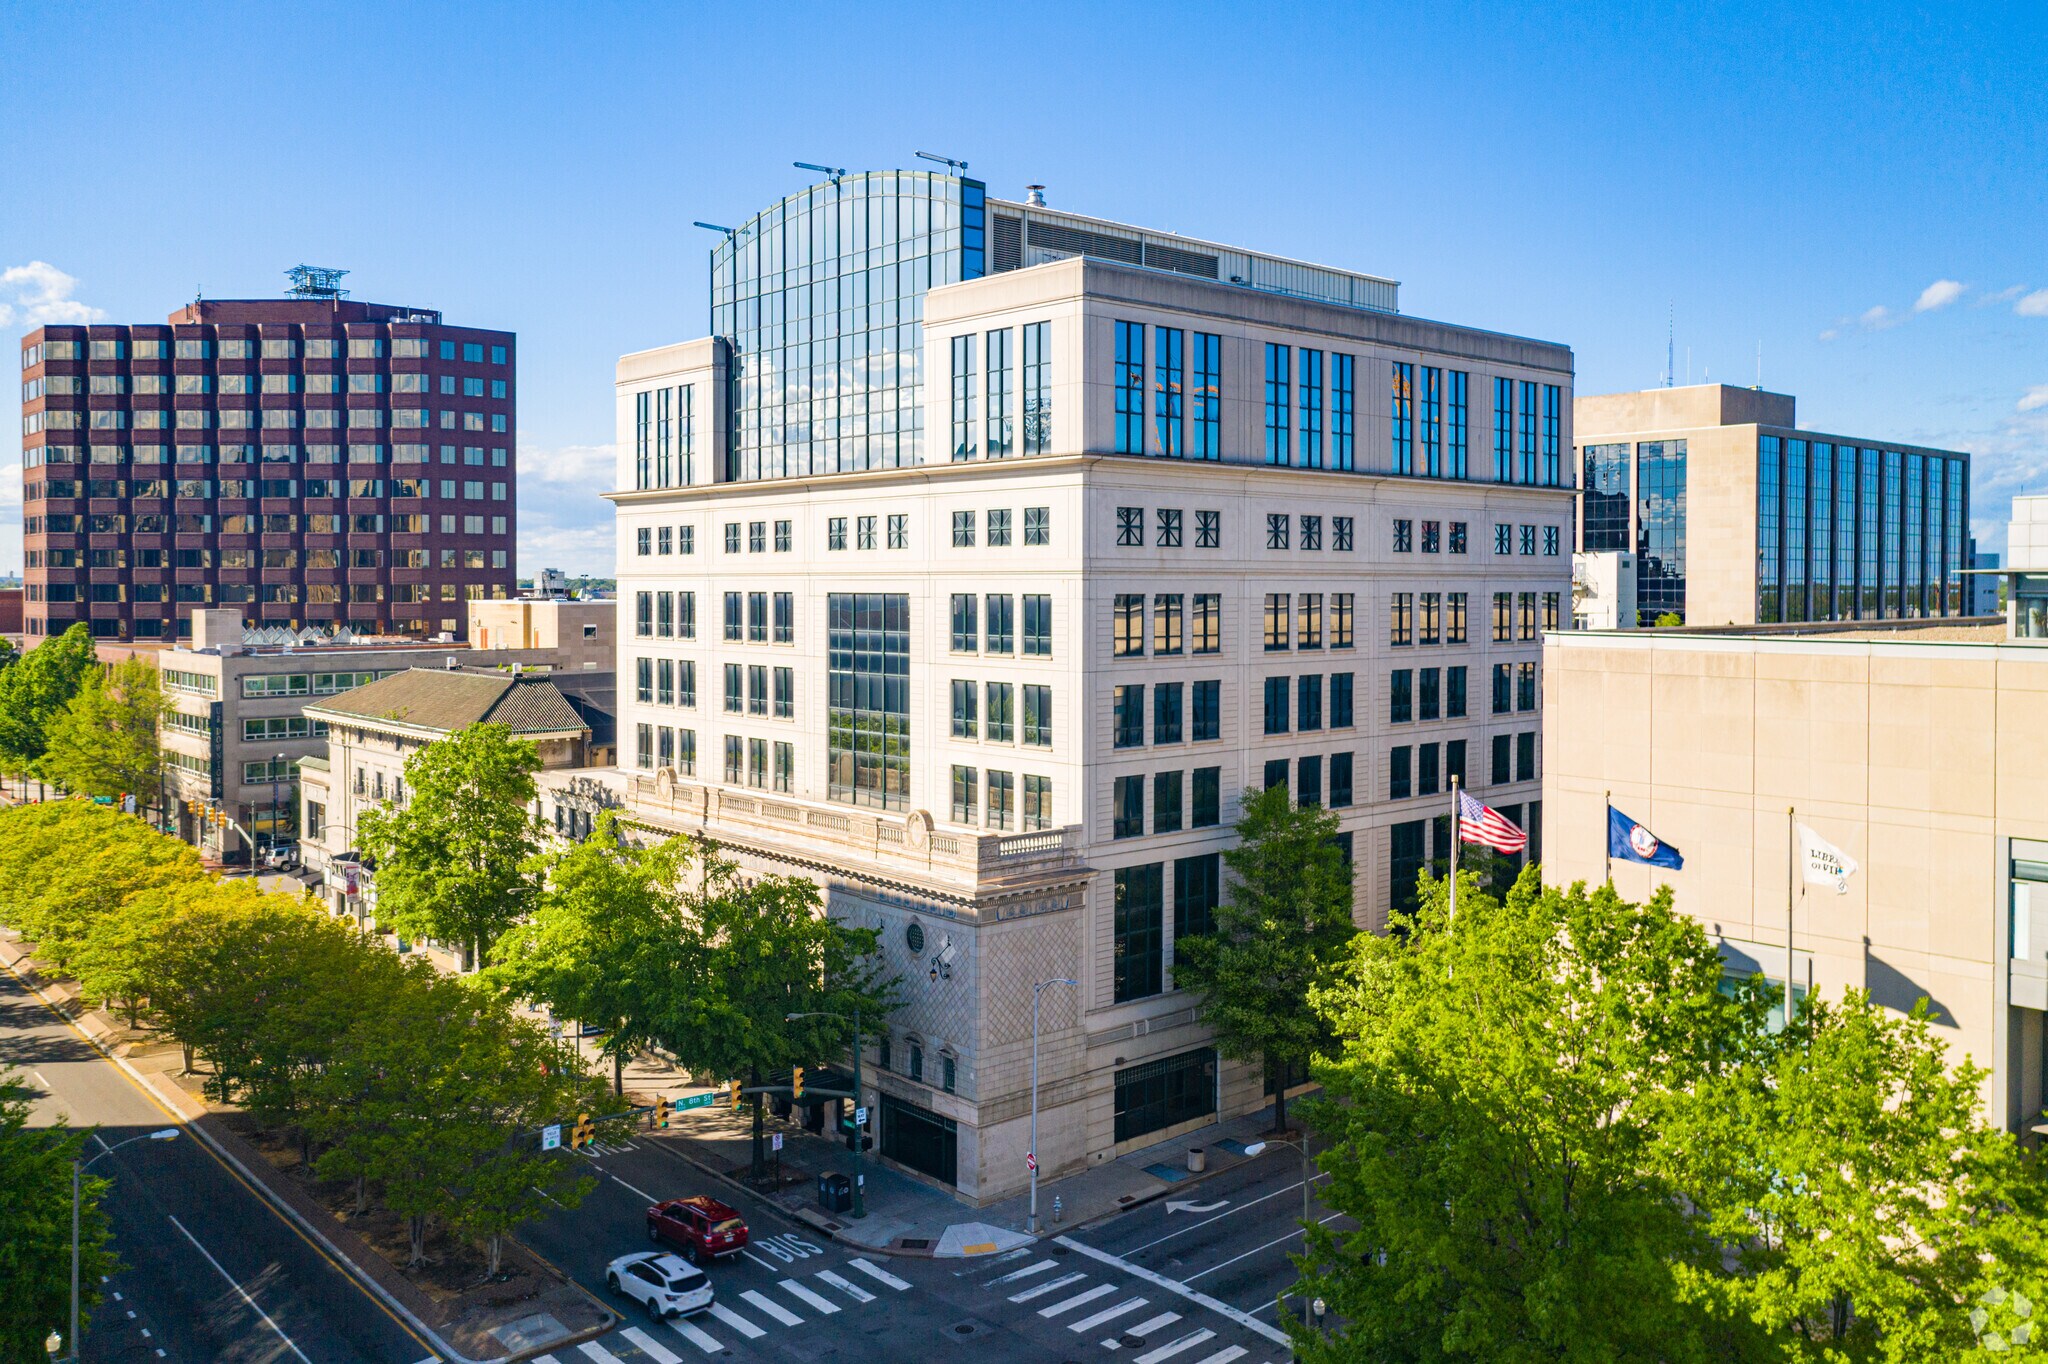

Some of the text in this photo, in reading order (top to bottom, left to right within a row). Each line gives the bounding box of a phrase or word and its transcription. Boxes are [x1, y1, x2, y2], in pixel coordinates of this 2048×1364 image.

[688, 1097, 701, 1105] 8th
[703, 1094, 711, 1102] St
[753, 1233, 824, 1264] BUS
